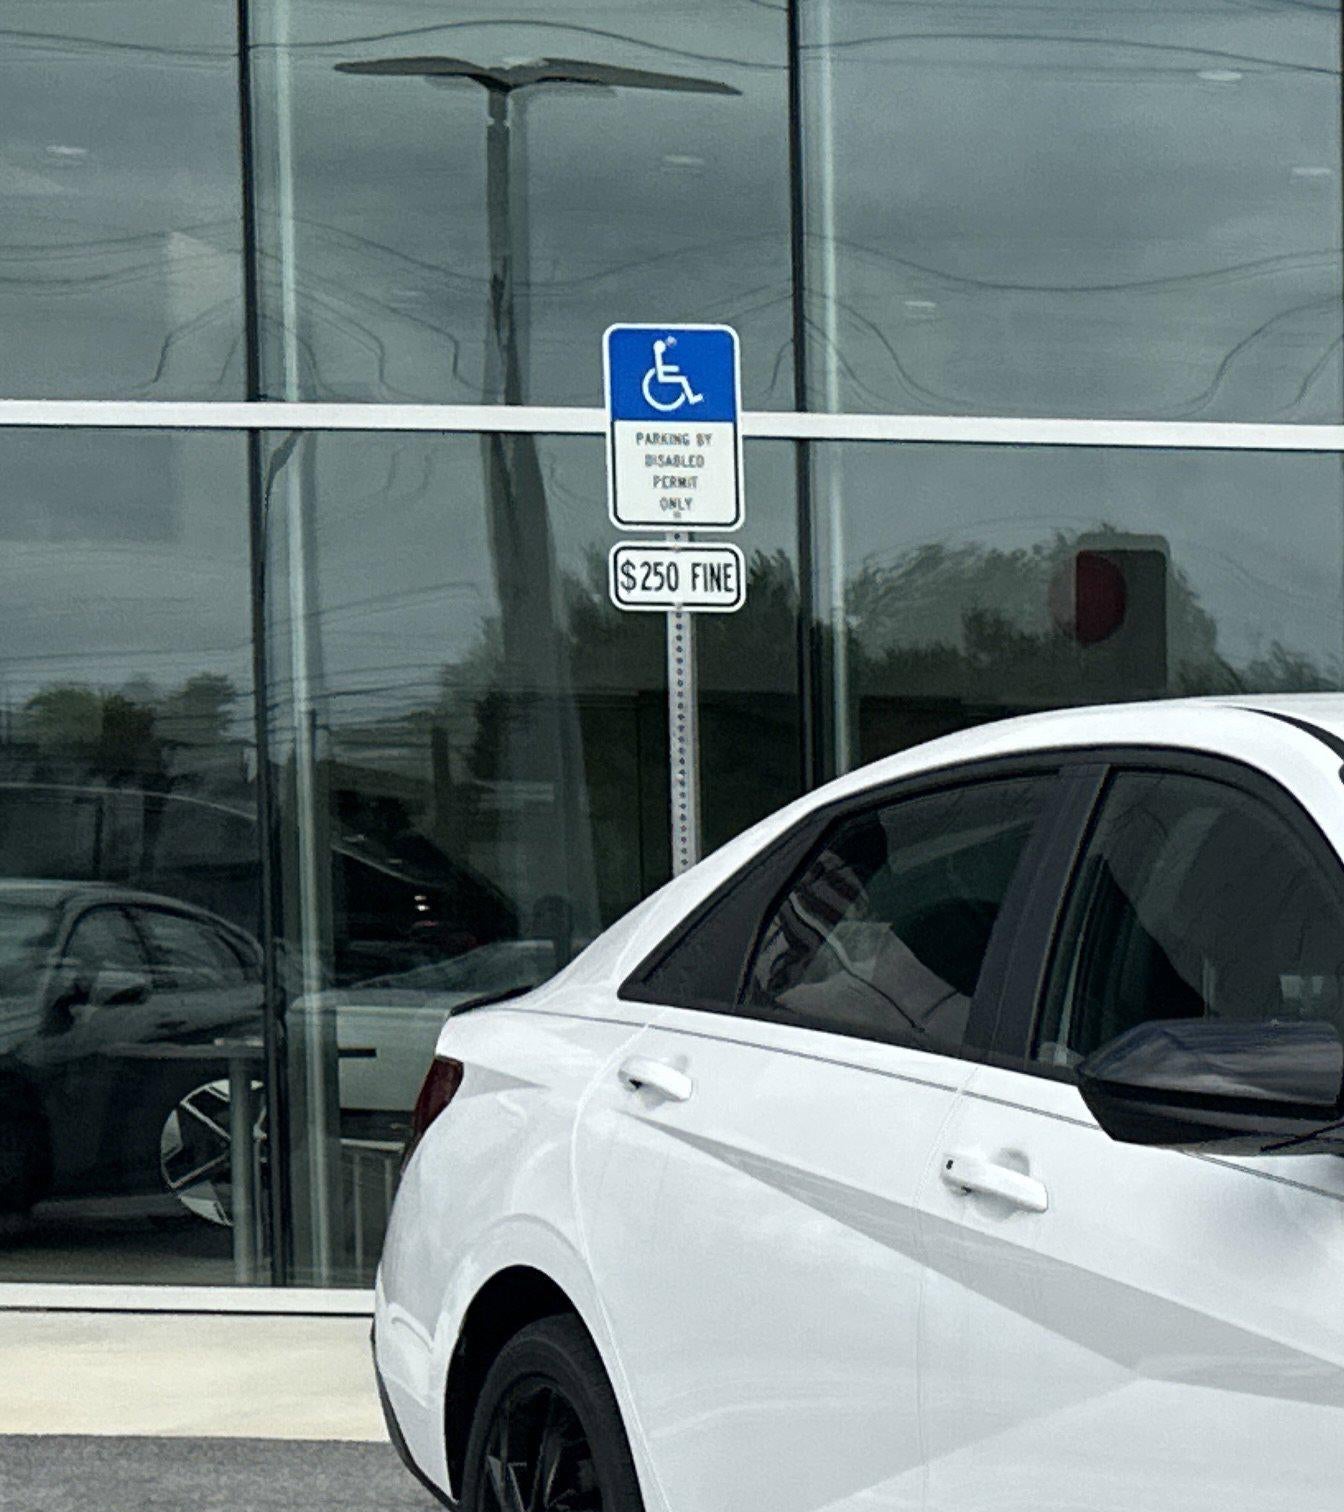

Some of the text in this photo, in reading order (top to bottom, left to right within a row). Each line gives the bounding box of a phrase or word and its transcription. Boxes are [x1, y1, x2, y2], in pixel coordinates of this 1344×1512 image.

[636, 432, 713, 447] PARKING BY
[645, 454, 704, 468] DISABLED
[653, 475, 698, 489] PERMIT
[660, 496, 693, 511] ONLY
[620, 559, 734, 592] $250 FINE
